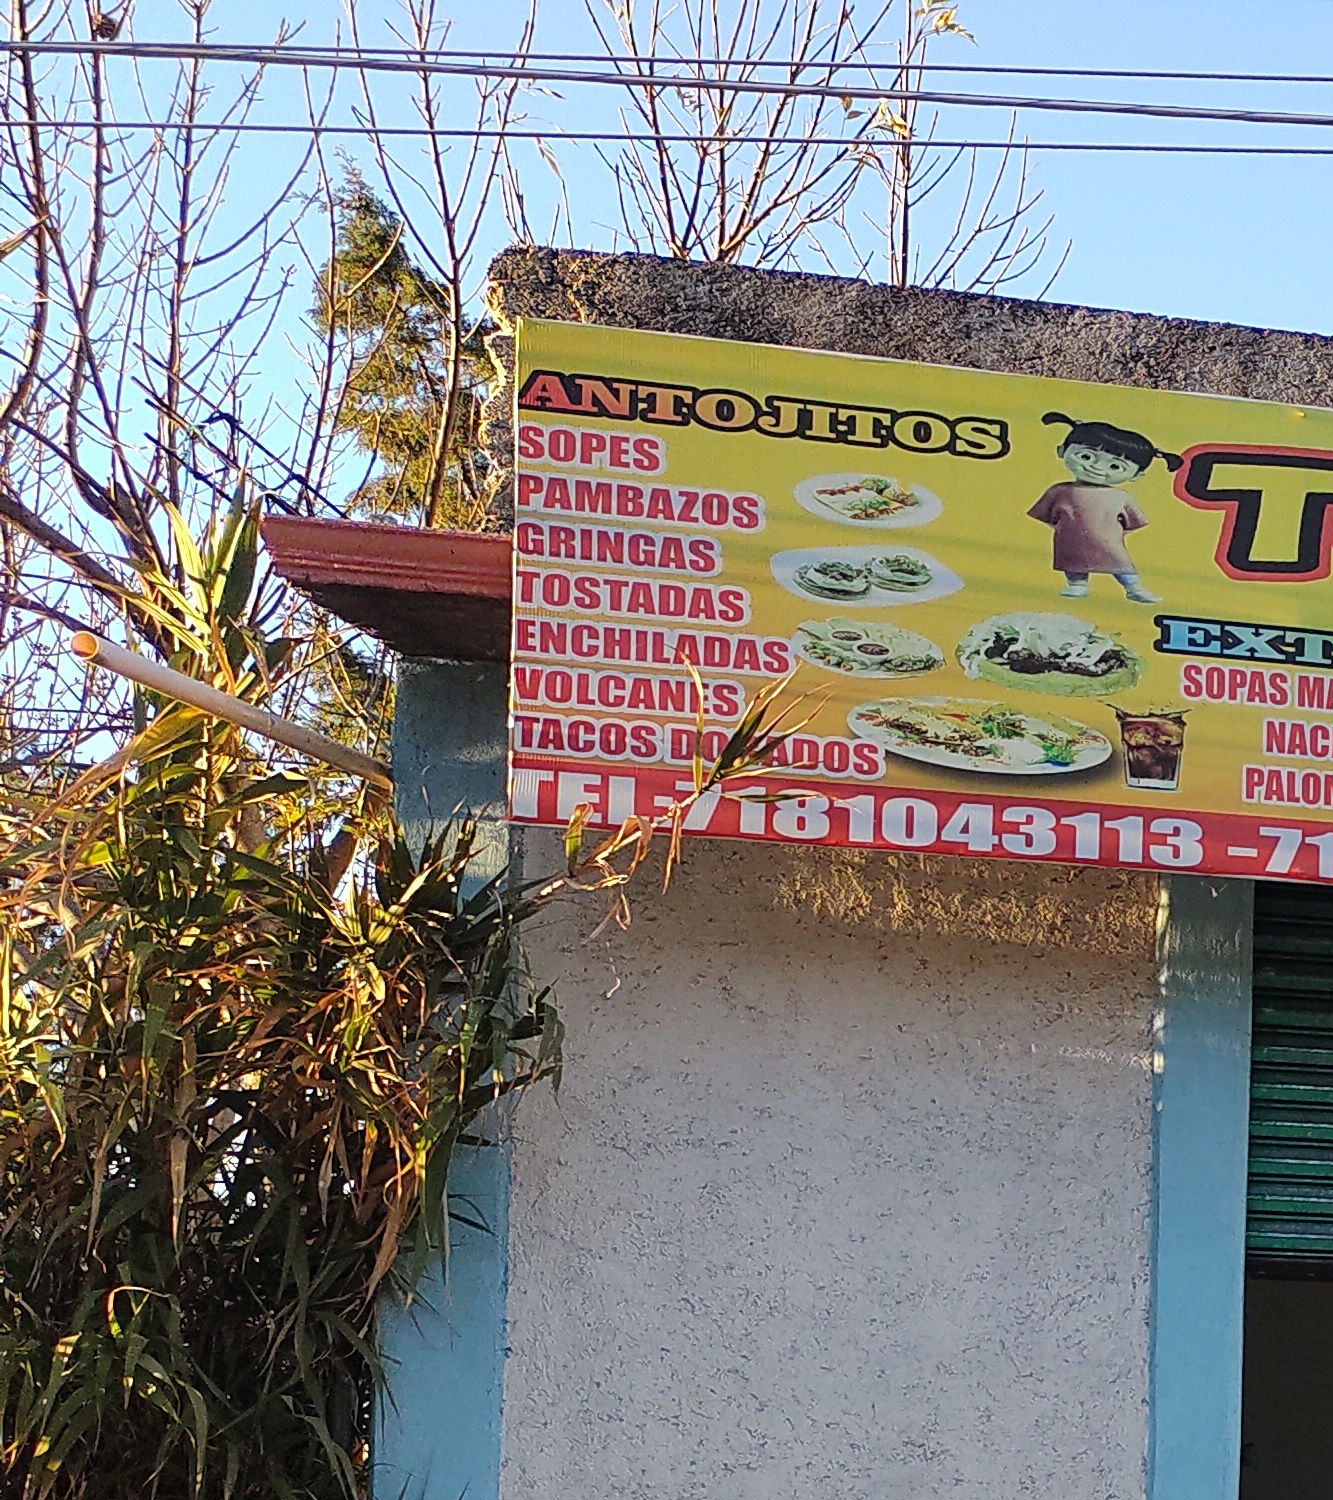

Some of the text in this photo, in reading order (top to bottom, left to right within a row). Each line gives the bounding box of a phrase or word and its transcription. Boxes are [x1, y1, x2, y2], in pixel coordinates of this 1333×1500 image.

[518, 372, 1006, 456] ANTOJITOS
[518, 425, 660, 472] SOPES
[517, 473, 759, 530] PAMBAZOS
[516, 522, 716, 573] GRINGAS
[517, 570, 745, 623] TOSTADAS
[516, 619, 791, 674] ENCHILADAS
[514, 667, 739, 717] VOLCANES
[1182, 664, 1289, 706] SOPAS
[514, 715, 880, 776] TACOS DOADOS
